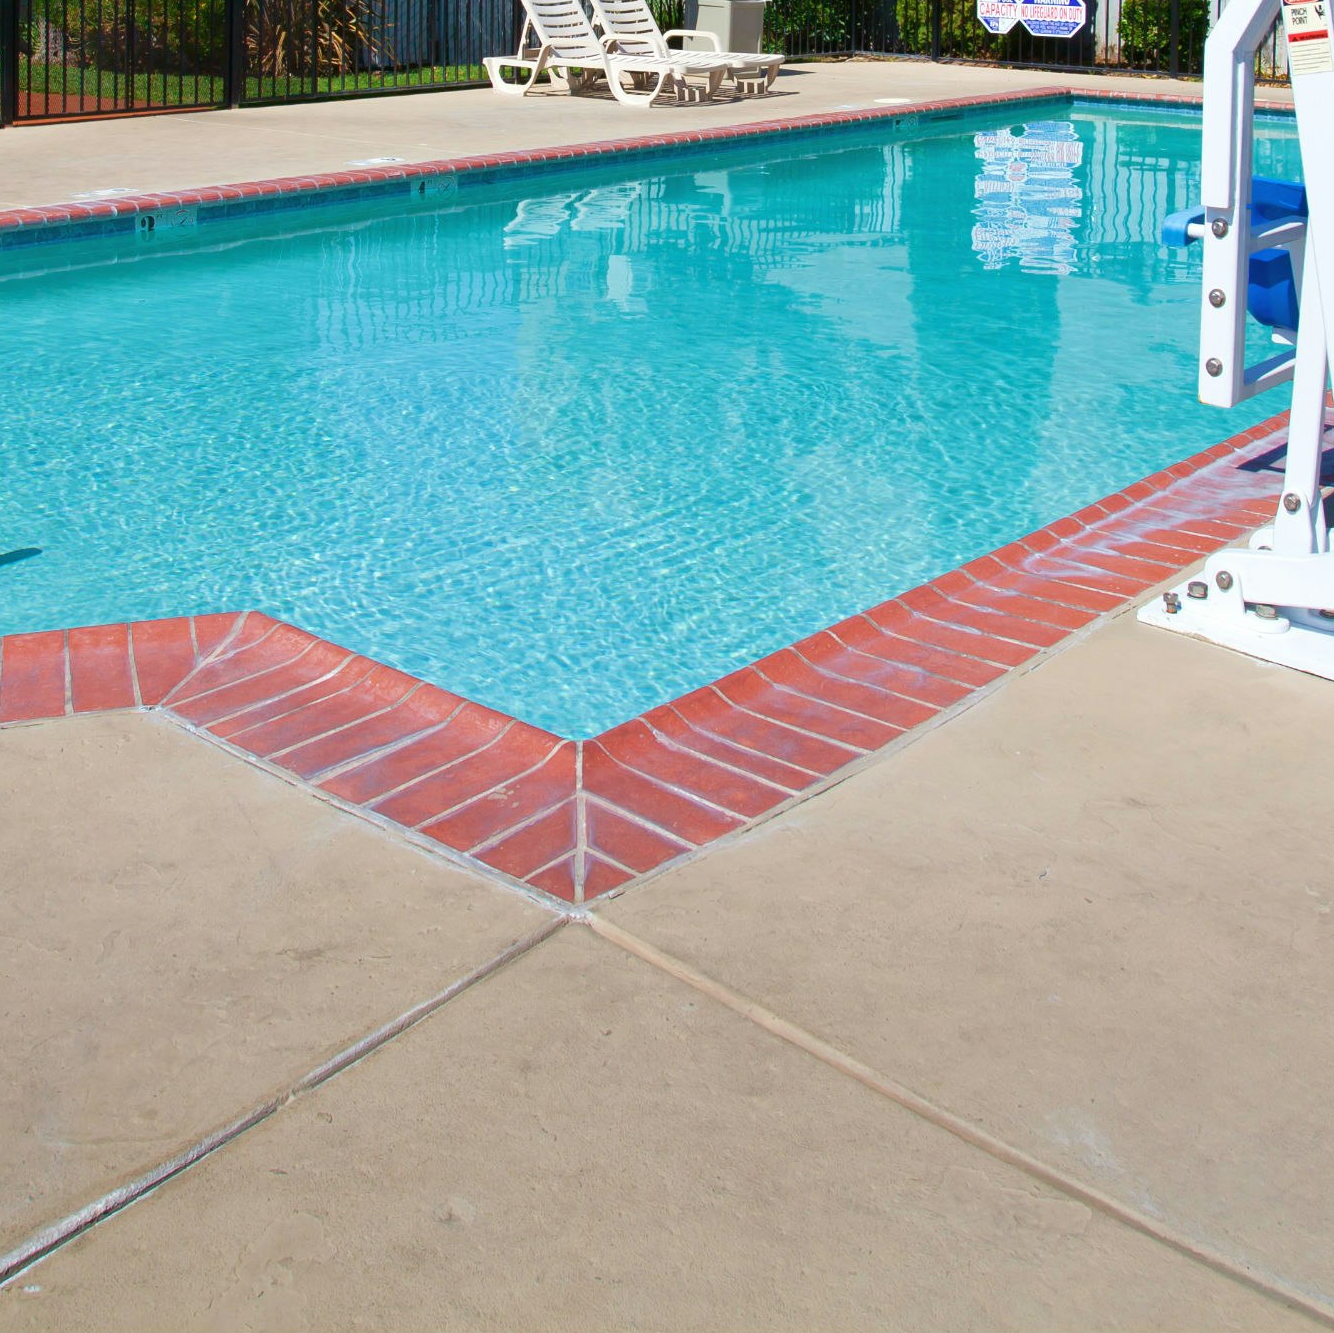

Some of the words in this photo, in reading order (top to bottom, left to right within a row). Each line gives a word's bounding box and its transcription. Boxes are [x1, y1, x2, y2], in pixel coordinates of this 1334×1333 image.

[979, 2, 1018, 17] CAPACITY
[1020, 5, 1028, 18] NO
[1029, 5, 1058, 20] LIFEGUARD
[1060, 7, 1068, 20] ON
[1069, 7, 1083, 21] DUTY
[1291, 7, 1307, 17] PINCH
[1292, 16, 1308, 26] POINT
